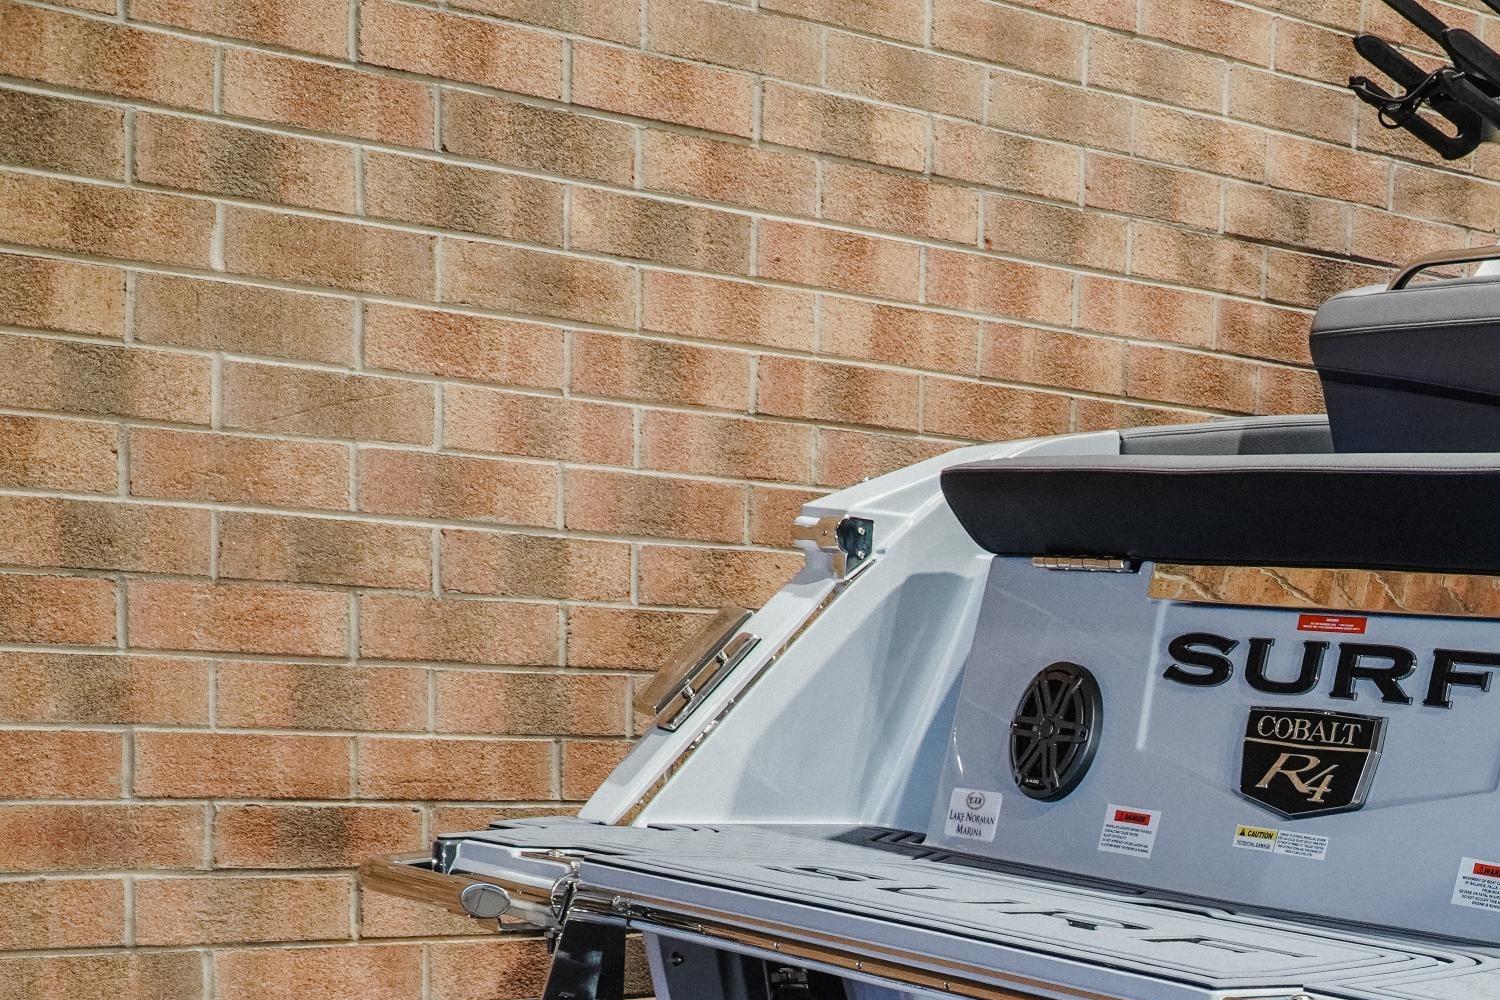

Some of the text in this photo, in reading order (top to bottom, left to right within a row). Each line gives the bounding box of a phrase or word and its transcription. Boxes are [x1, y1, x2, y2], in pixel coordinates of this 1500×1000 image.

[1254, 714, 1364, 748] COBALT
[1255, 752, 1339, 804] R4
[950, 809, 995, 825] LAKE NORMAN
[956, 824, 982, 837] MARINA
[1248, 830, 1274, 839] CAUTION
